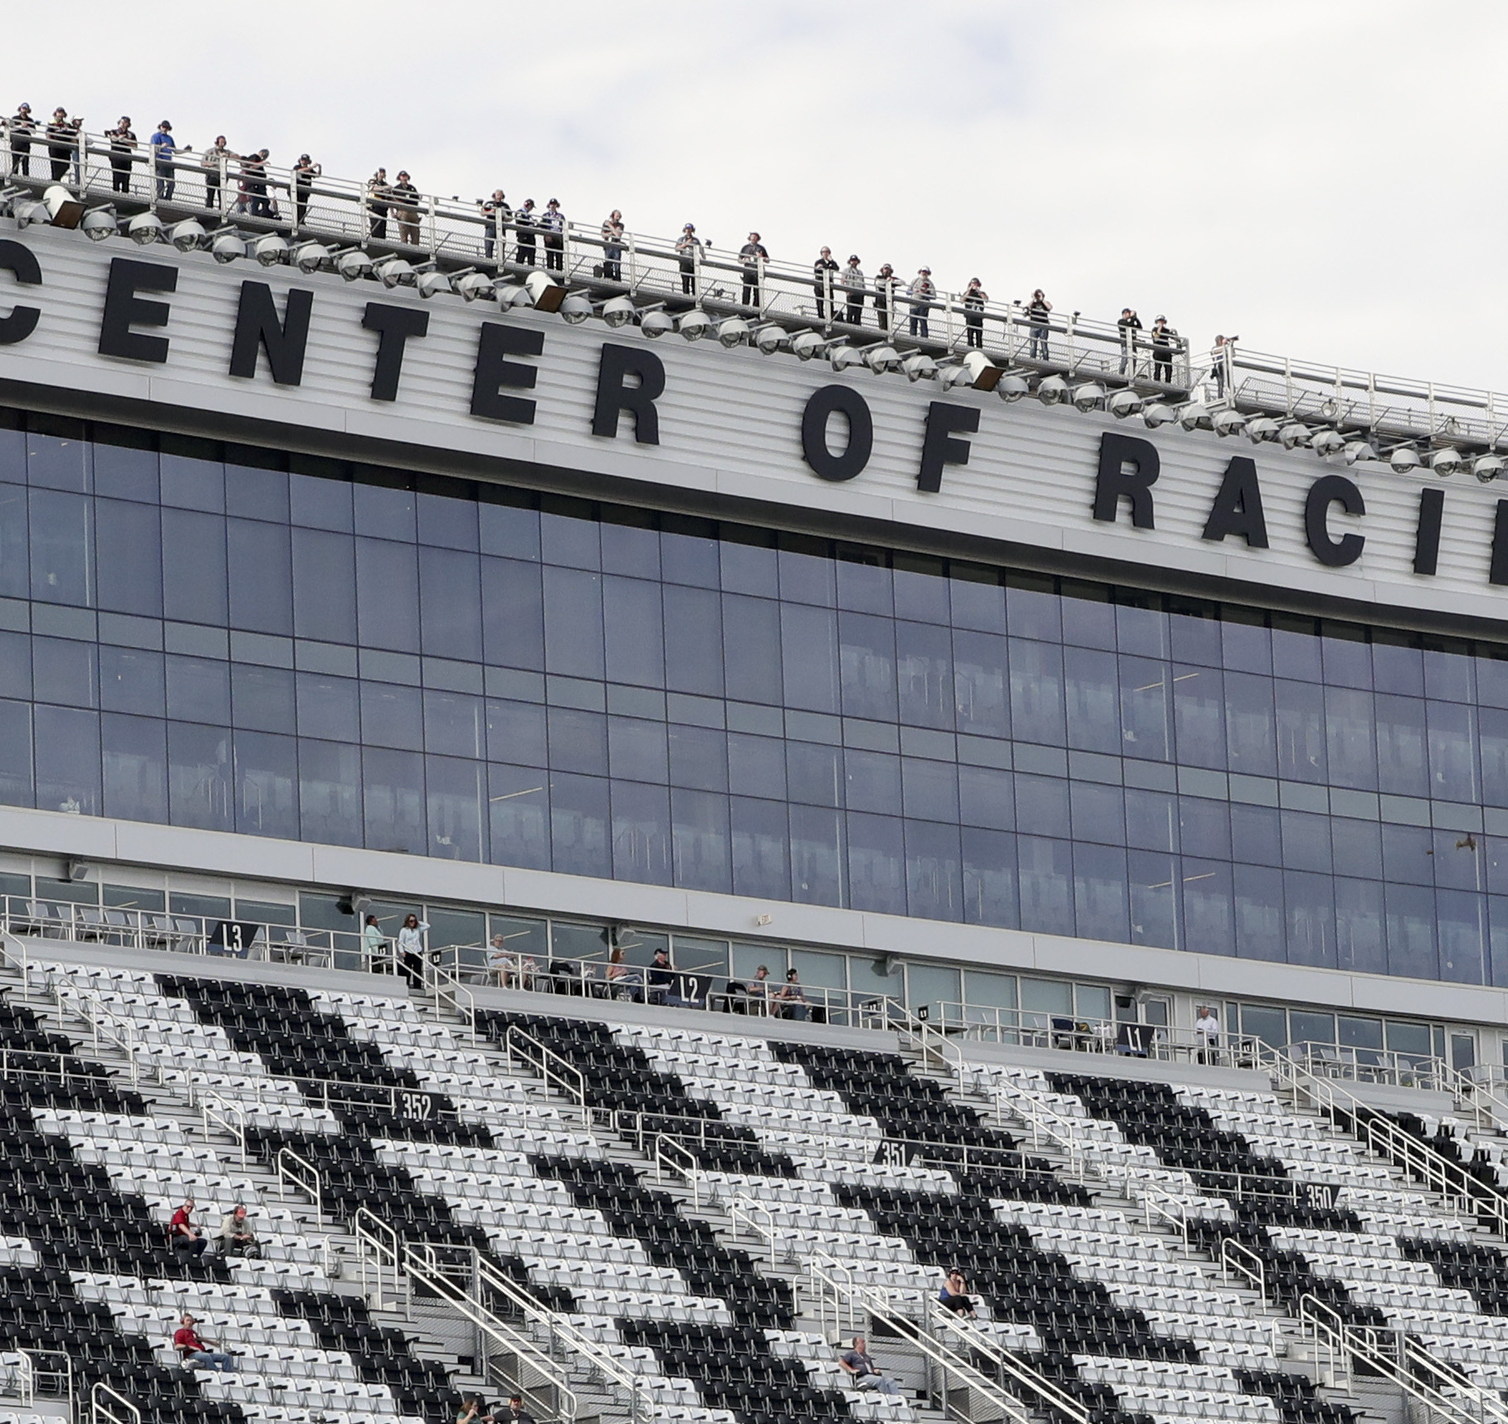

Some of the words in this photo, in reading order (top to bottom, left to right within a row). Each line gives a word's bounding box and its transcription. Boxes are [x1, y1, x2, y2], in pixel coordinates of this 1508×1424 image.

[801, 384, 981, 493] OF
[222, 923, 243, 952] L3
[679, 975, 699, 1003] L2
[1126, 1026, 1143, 1052] L1
[402, 1093, 432, 1121] 352
[881, 1141, 907, 1167] 351
[1306, 1184, 1331, 1210] 350
